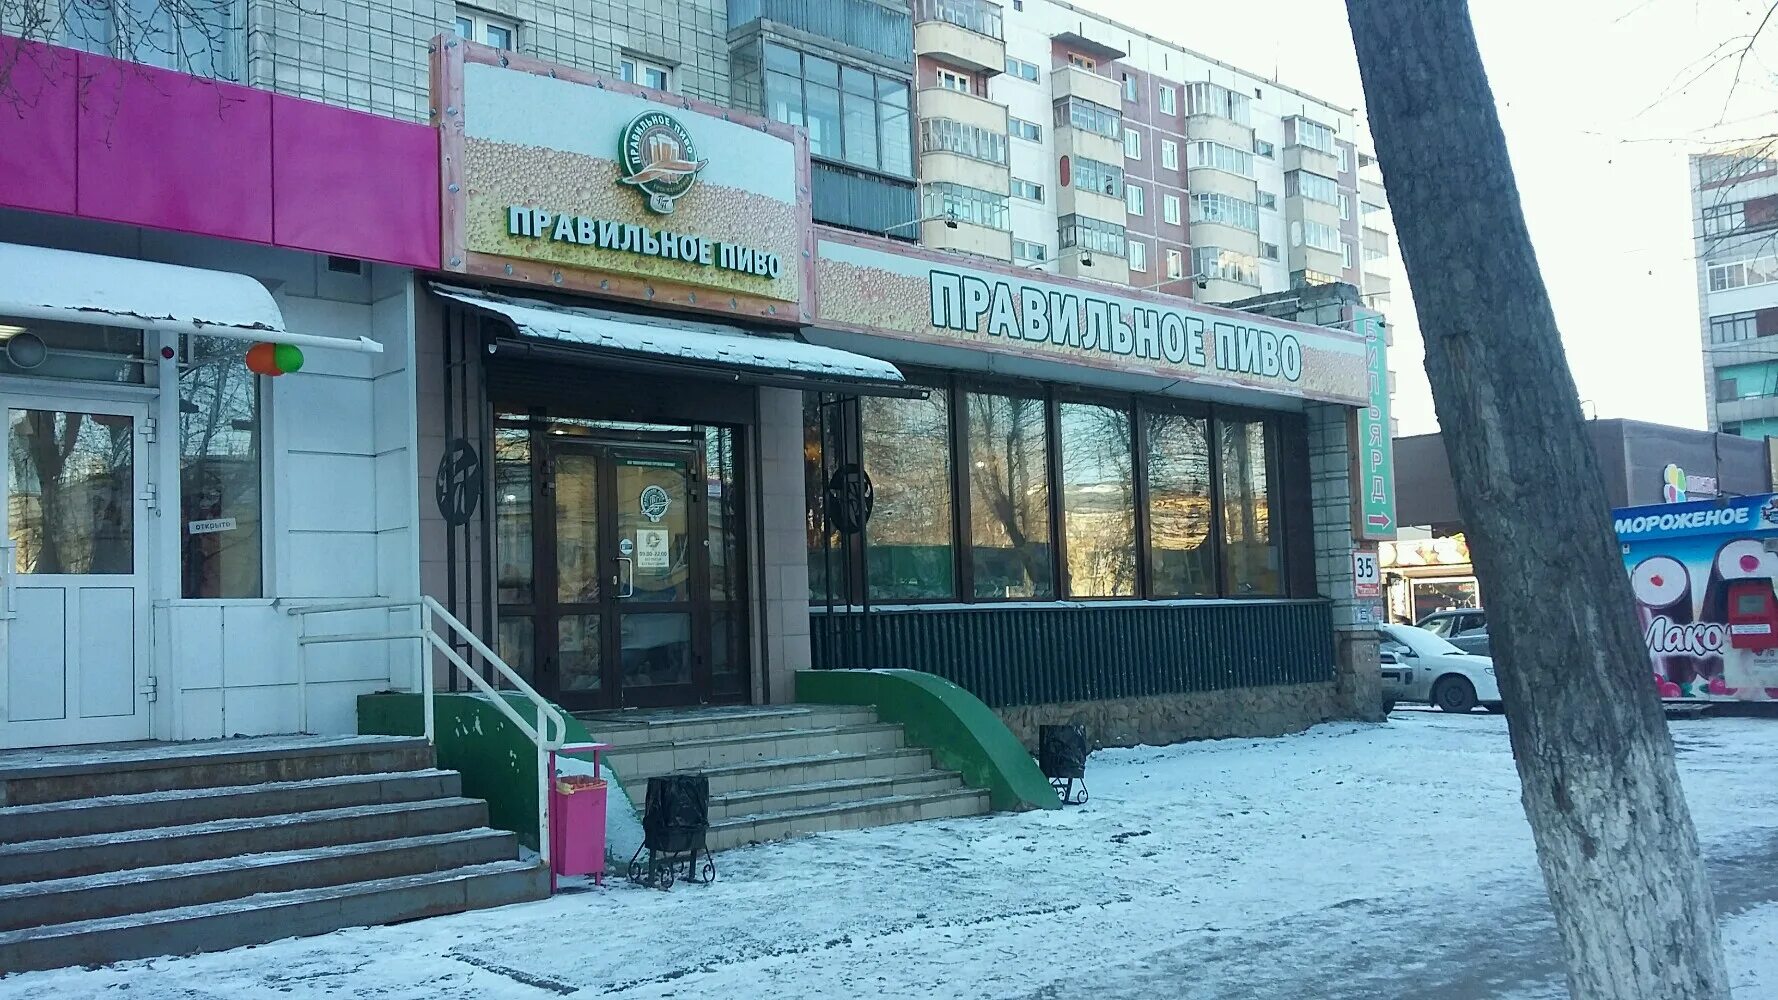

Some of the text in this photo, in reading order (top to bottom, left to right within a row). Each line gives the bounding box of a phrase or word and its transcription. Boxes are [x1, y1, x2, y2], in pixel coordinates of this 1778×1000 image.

[630, 115, 693, 164] ПРАВИЛЬНОЕ ПИВО
[508, 206, 783, 278] ПРАВИЛЬНОЕ ПИВО
[929, 269, 1301, 381] ПРАВИЛЬНОЕ ПИВО
[1365, 319, 1386, 504] БИЛЬЯРД
[1615, 507, 1749, 533] МОРОЖЕНОЕ
[1357, 557, 1373, 578] 35
